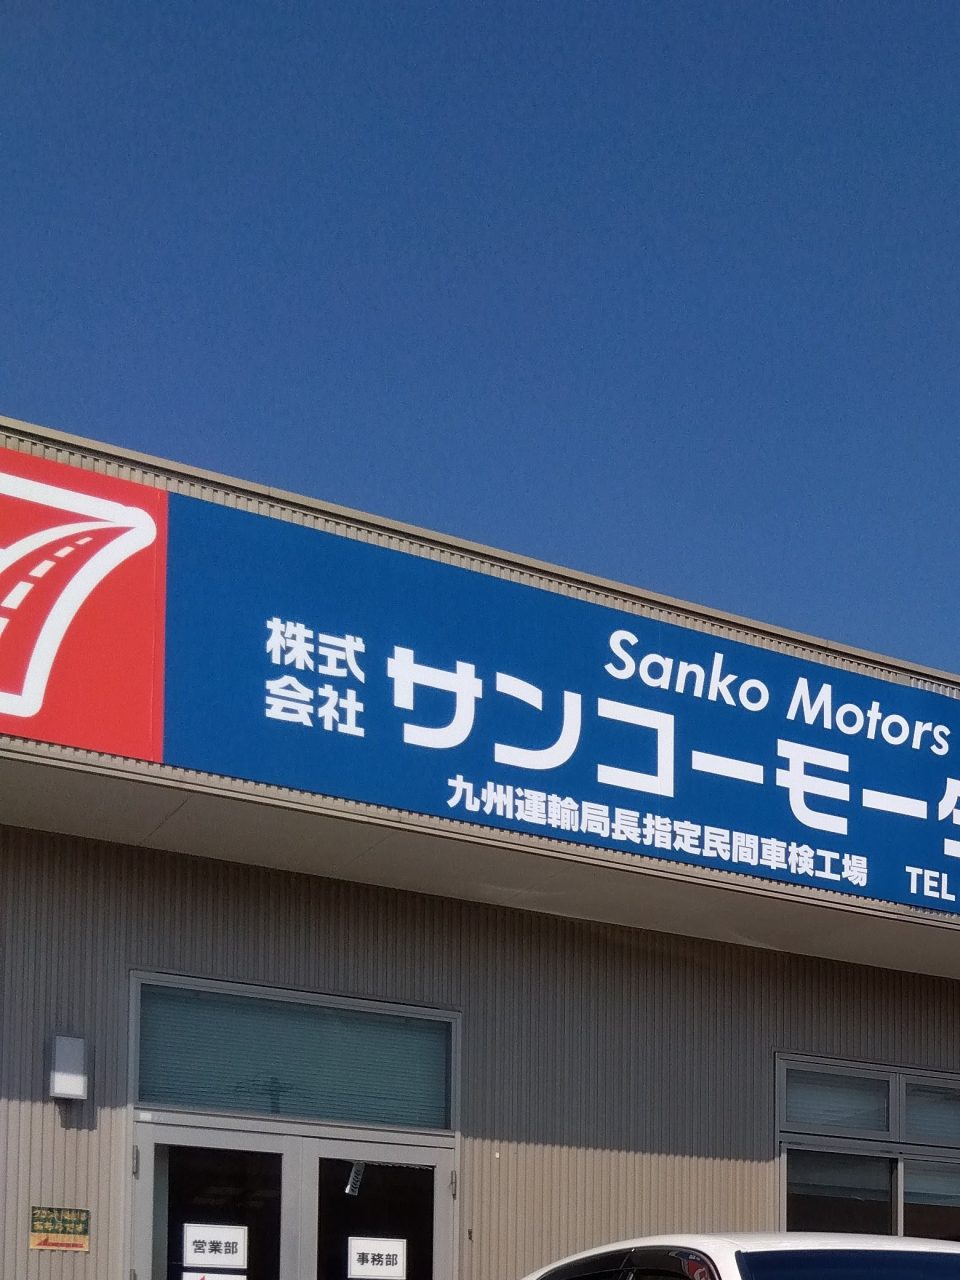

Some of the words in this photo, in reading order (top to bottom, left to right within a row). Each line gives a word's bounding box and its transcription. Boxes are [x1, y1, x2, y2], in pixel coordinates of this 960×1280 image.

[265, 617, 365, 684] 株式
[265, 675, 365, 738] 会社
[604, 630, 770, 712] Sanko
[786, 677, 951, 756] Motors
[446, 774, 868, 887] 九州運輸局長指定民間車検工場
[905, 866, 956, 902] TEL
[192, 1239, 239, 1255] 営業部
[356, 1252, 399, 1267] 事務部
